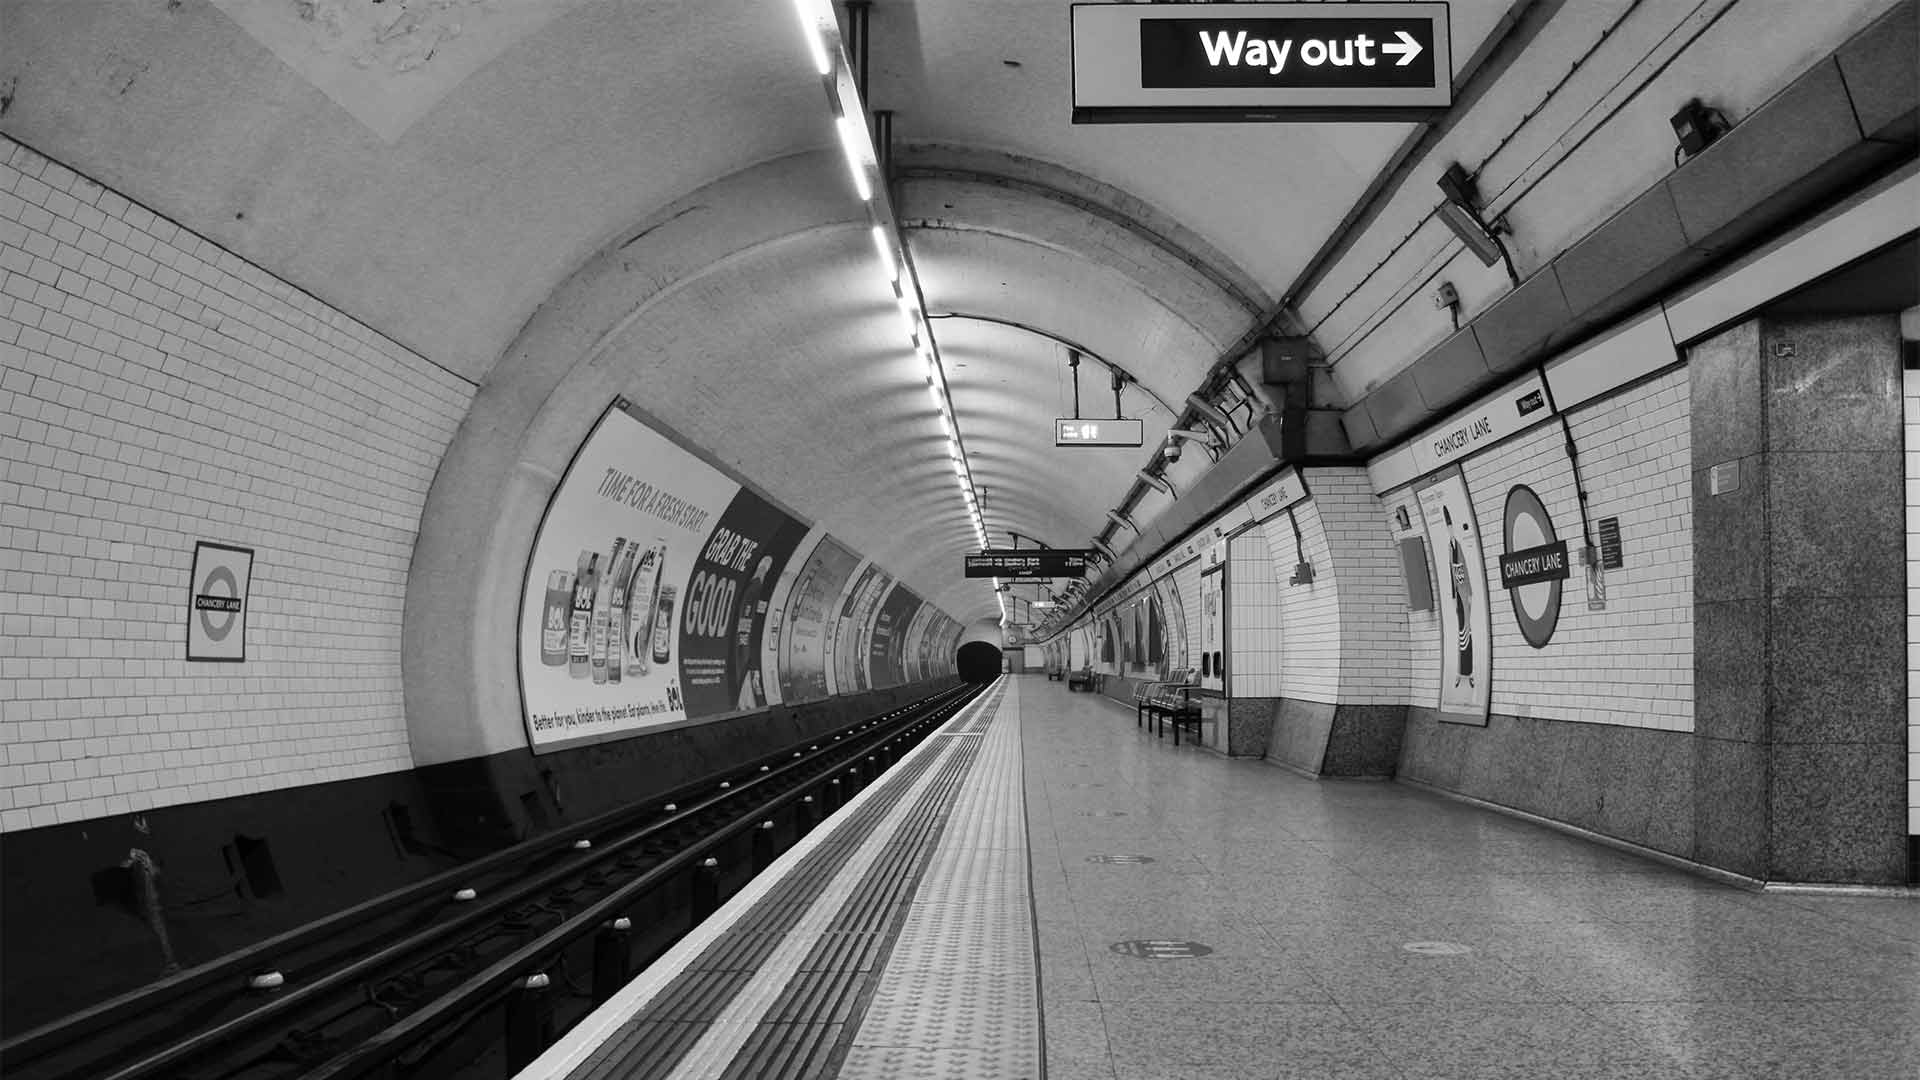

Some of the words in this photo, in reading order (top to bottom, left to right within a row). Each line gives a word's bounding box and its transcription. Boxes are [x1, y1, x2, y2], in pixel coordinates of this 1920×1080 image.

[1199, 30, 1293, 75] Way
[1300, 33, 1376, 67] out
[1433, 428, 1470, 457] CHANCERY
[1468, 416, 1492, 441] LANE
[597, 466, 633, 502] TIME
[624, 478, 653, 513] FOR
[644, 488, 660, 515] A
[656, 492, 688, 527] FRESH
[678, 504, 709, 533] START
[704, 527, 742, 566] GRAB
[730, 537, 759, 572] THE
[1504, 557, 1541, 579] CHANCERY
[1541, 551, 1563, 571] LANE
[198, 598, 225, 609] CHANCERY
[227, 600, 240, 610] LANE
[685, 569, 737, 638] GOOD
[532, 714, 554, 731] Better
[554, 711, 564, 728] for
[576, 708, 595, 724] kinder
